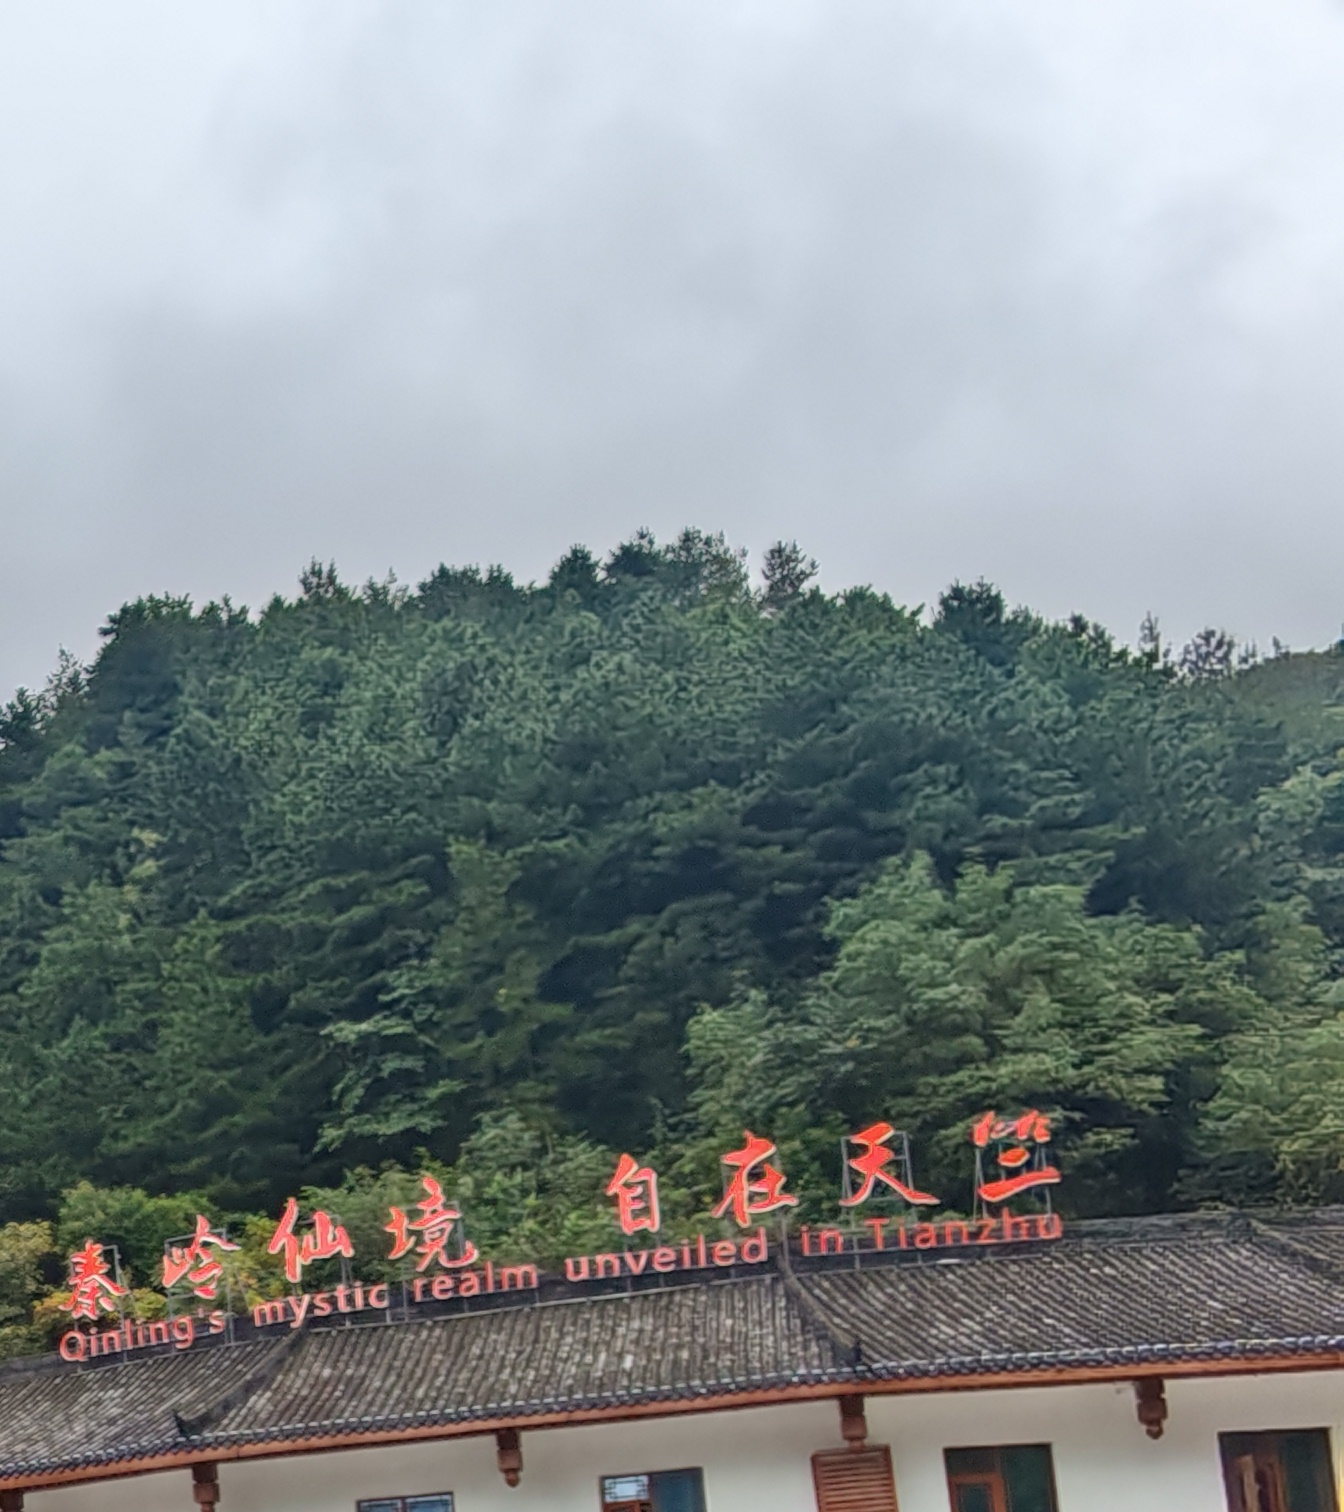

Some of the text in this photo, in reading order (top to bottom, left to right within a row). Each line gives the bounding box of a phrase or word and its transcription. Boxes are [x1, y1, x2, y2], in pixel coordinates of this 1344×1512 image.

[59, 1207, 1062, 1362] Qinling's mystic realm unveiled in Tianzhu
[60, 1110, 1061, 1320] 秦岭仙境 自在天竺
